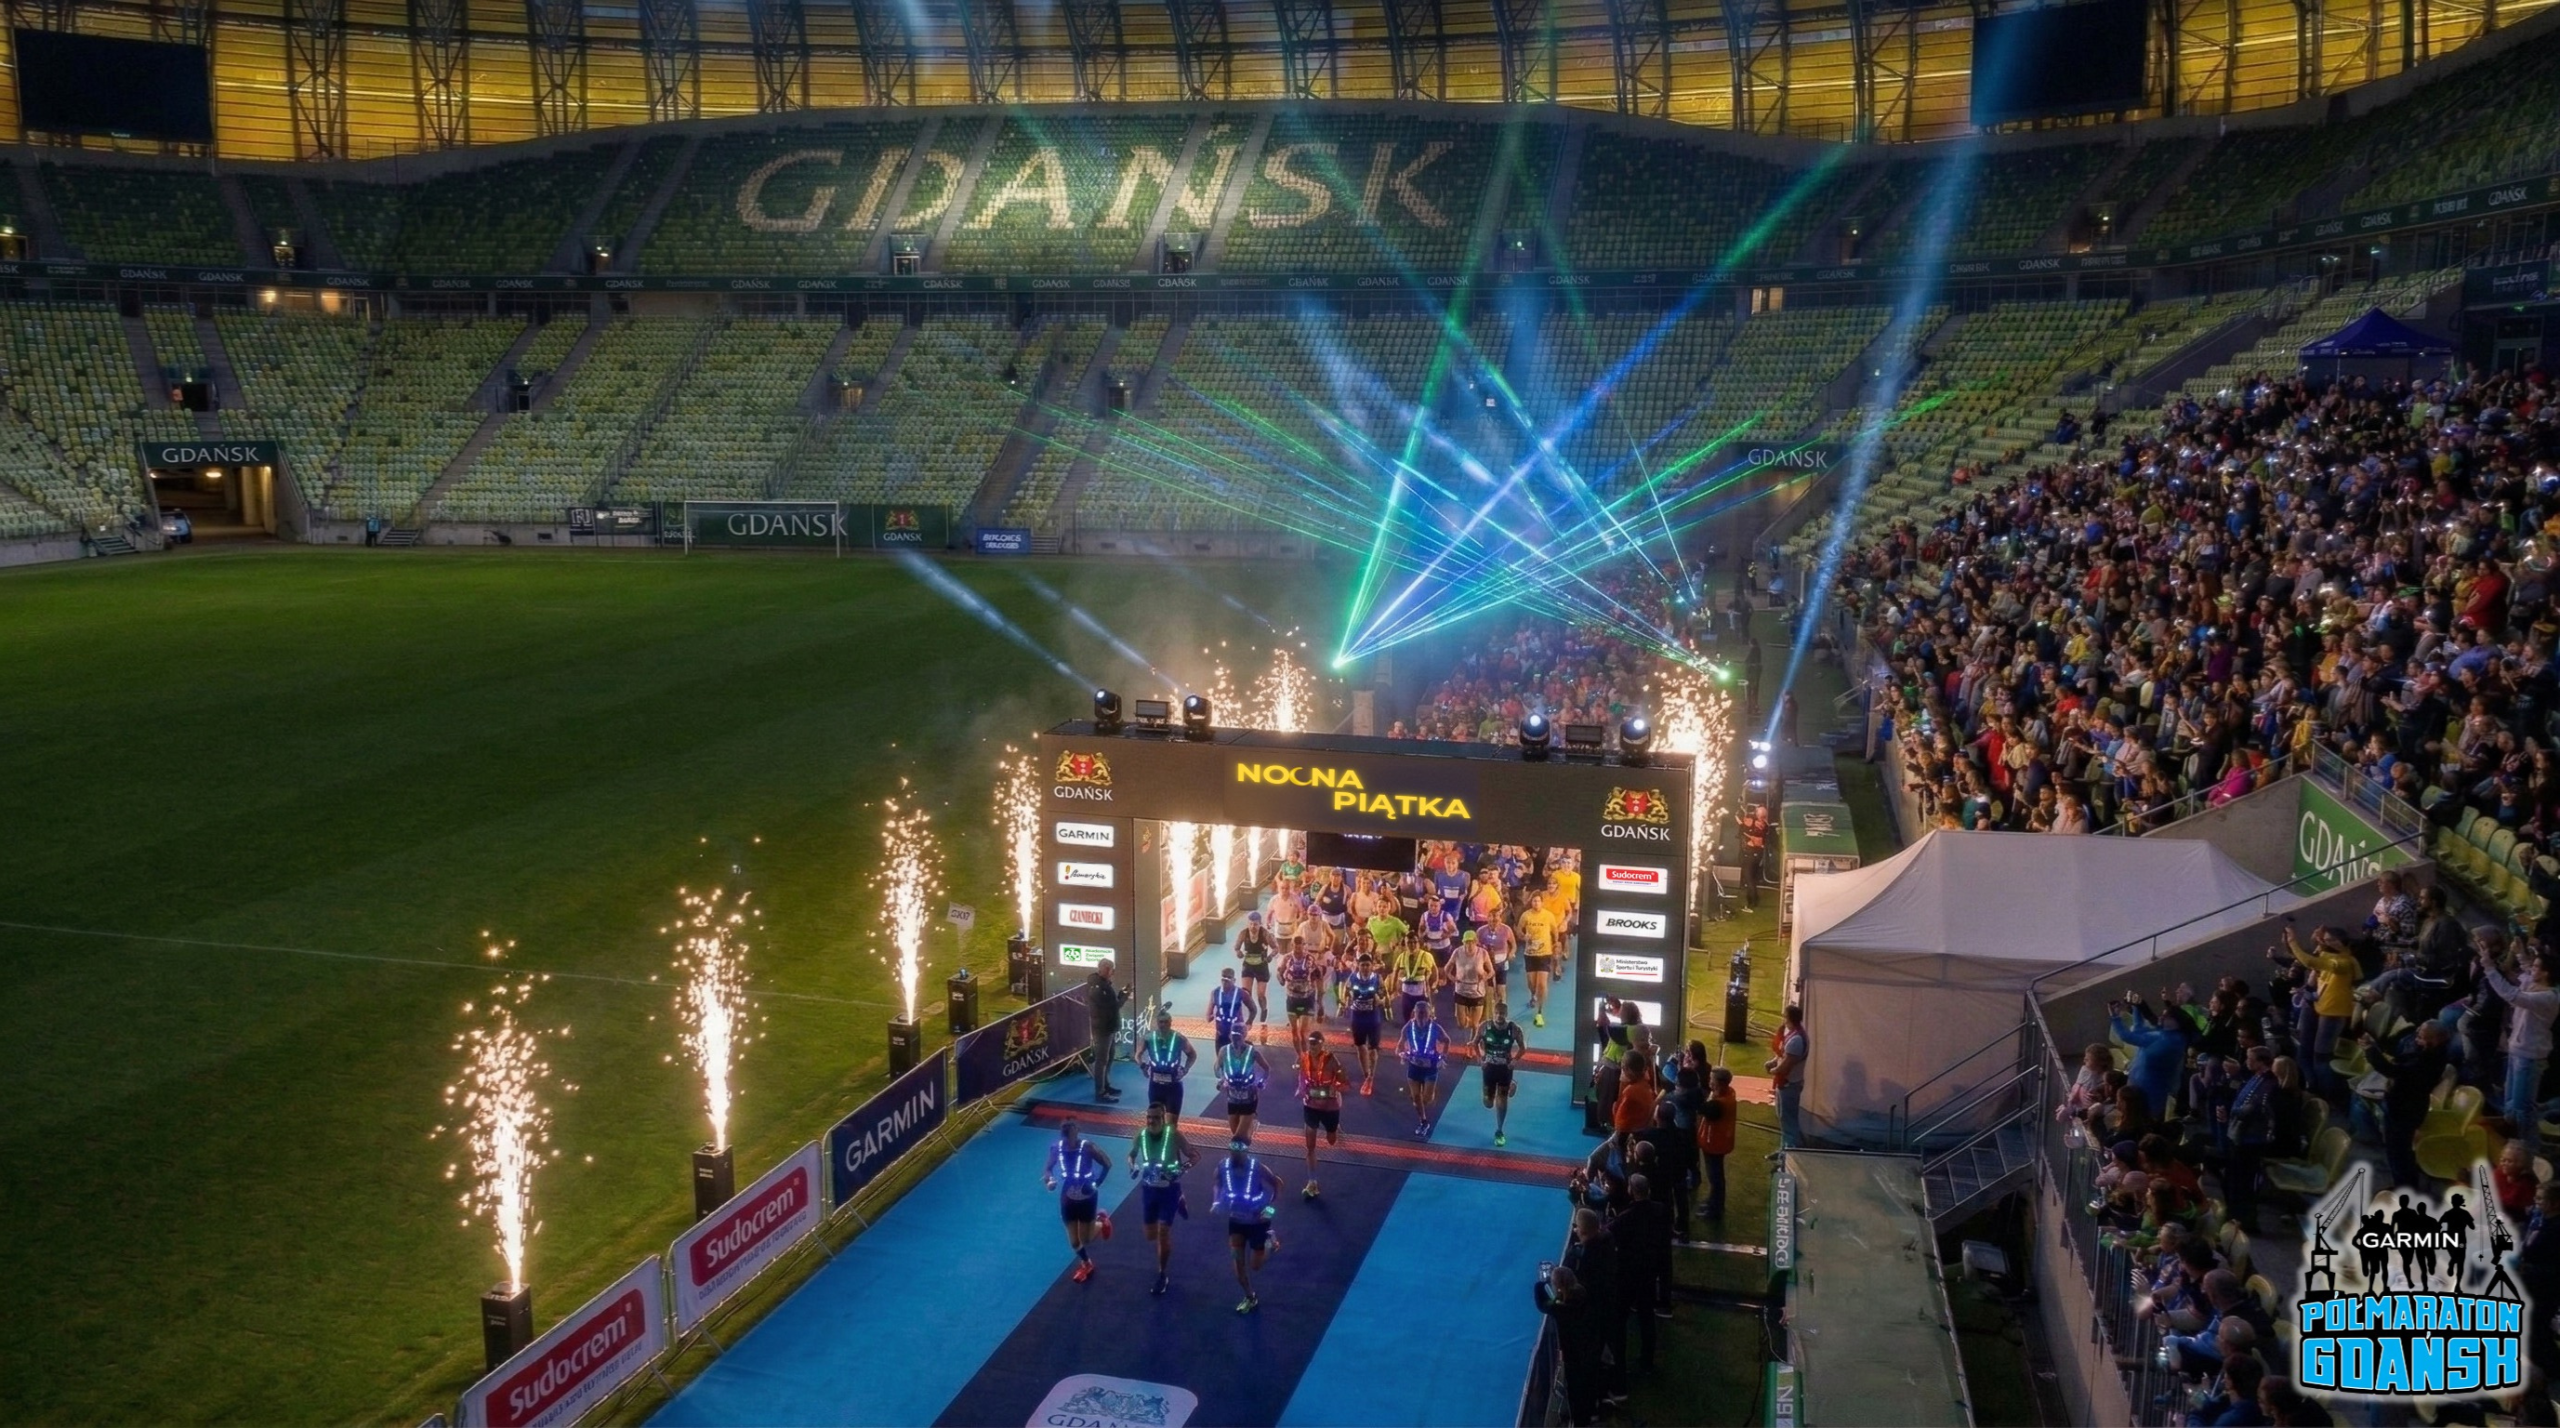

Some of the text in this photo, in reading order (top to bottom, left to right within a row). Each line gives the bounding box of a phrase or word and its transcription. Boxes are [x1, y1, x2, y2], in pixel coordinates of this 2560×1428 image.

[162, 444, 260, 463] GDAŃSK
[1237, 763, 1364, 790] NOCNA
[1054, 786, 1113, 801] GDAŃSK
[1333, 792, 1471, 820] PIĄTKA
[1058, 828, 1110, 841] GARMIN
[1601, 824, 1671, 841] GDAŃSK
[1069, 909, 1103, 925] CZANIECKI
[1606, 918, 1657, 930] BROOKS
[845, 1080, 935, 1172] GARMIN
[706, 1187, 794, 1269] Sudocrem
[509, 1315, 628, 1421] Sudocrem
